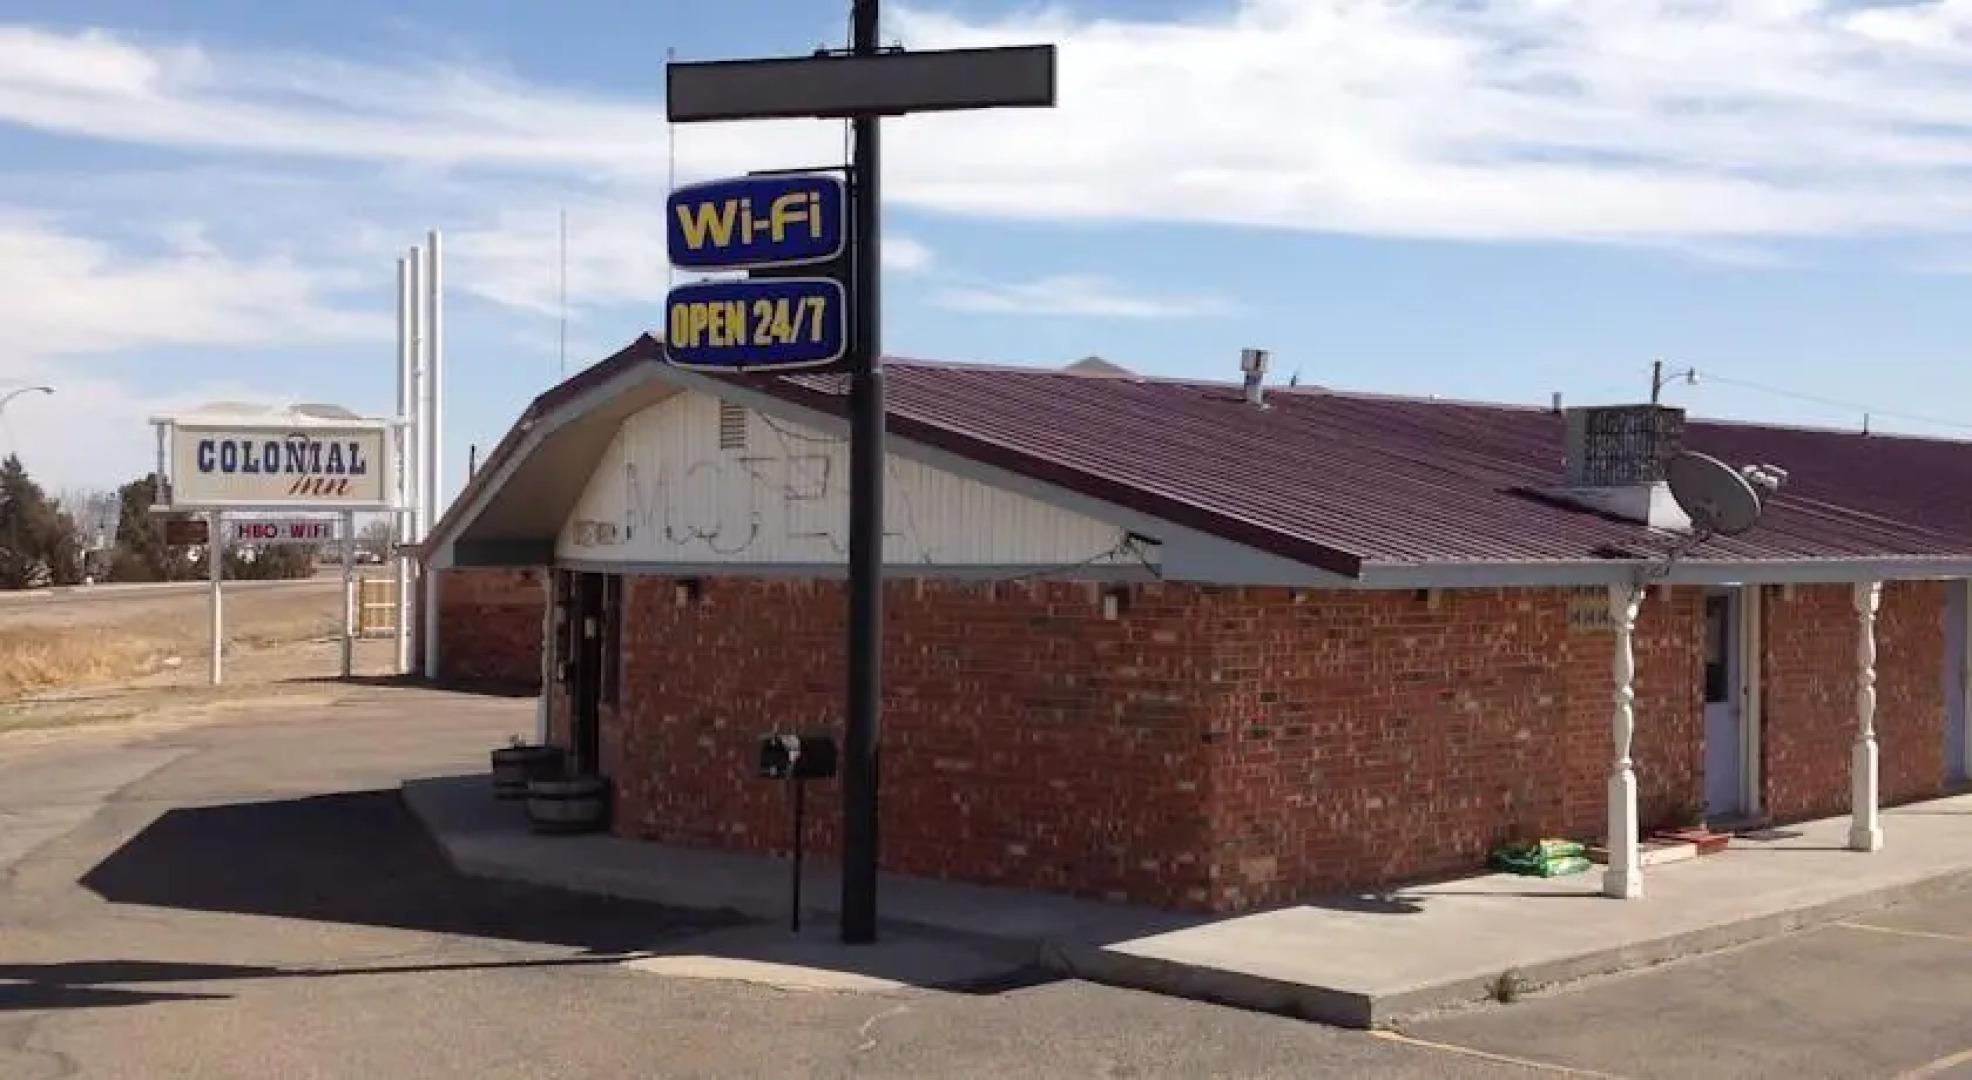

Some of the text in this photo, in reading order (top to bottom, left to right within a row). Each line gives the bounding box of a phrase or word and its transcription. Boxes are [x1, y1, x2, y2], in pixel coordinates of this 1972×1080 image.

[675, 191, 822, 250] Wi-Fi
[671, 295, 825, 348] OPEN 24/7
[197, 439, 366, 474] COLONIAL
[239, 524, 278, 539] HBO
